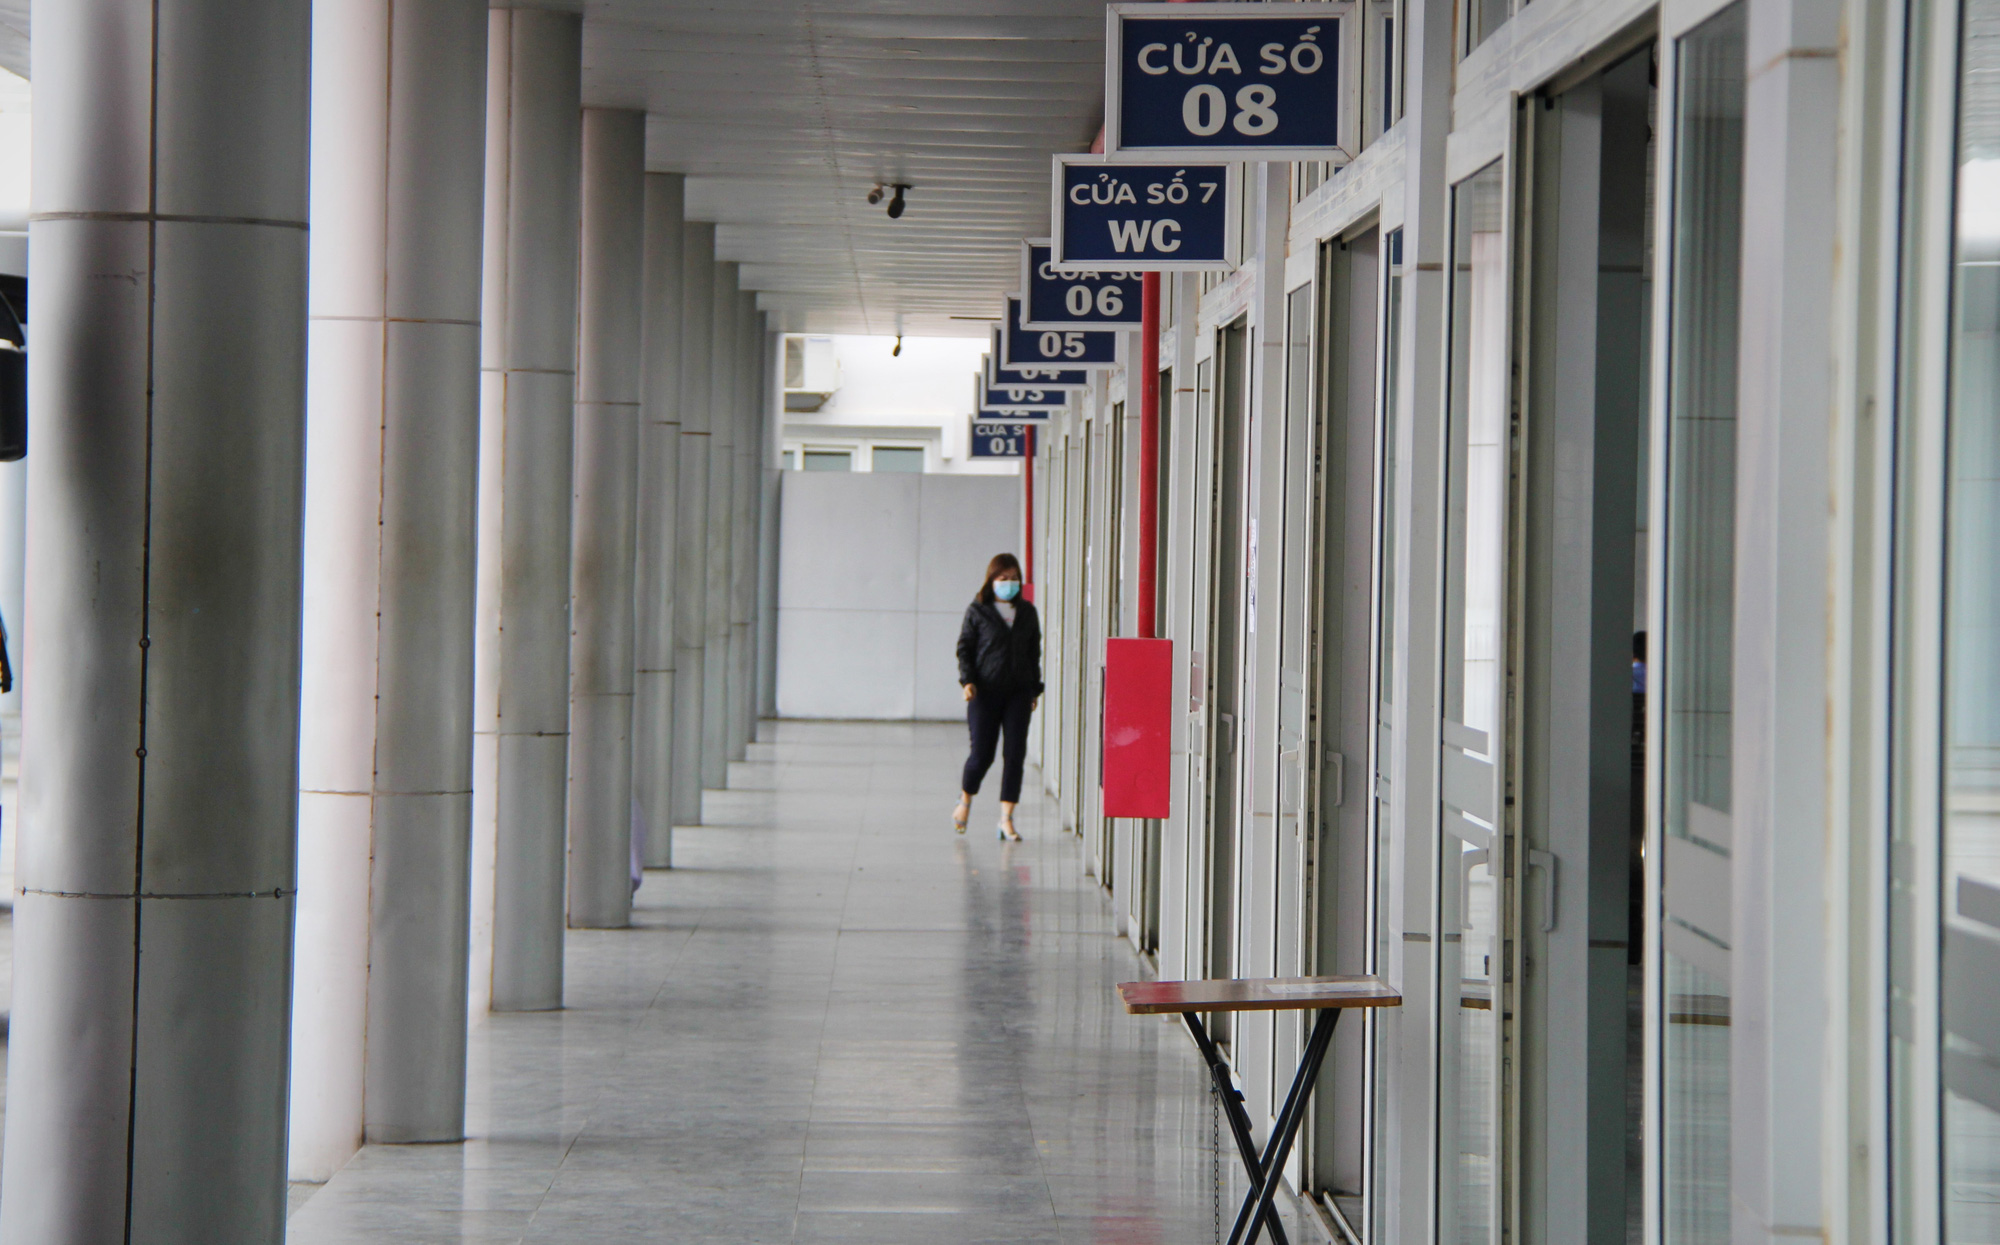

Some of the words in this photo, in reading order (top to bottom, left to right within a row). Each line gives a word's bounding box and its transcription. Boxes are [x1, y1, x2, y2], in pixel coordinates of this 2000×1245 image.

[1137, 33, 1242, 75] CỬA
[1259, 27, 1323, 75] SỐ
[1182, 84, 1279, 136] 08
[1070, 173, 1137, 205] CỬA
[1147, 170, 1189, 205] SỐ
[1199, 183, 1218, 203] 7
[1107, 219, 1181, 253] WC
[1065, 285, 1124, 316] 06
[1039, 331, 1086, 358] 05
[989, 437, 1019, 455] 01
